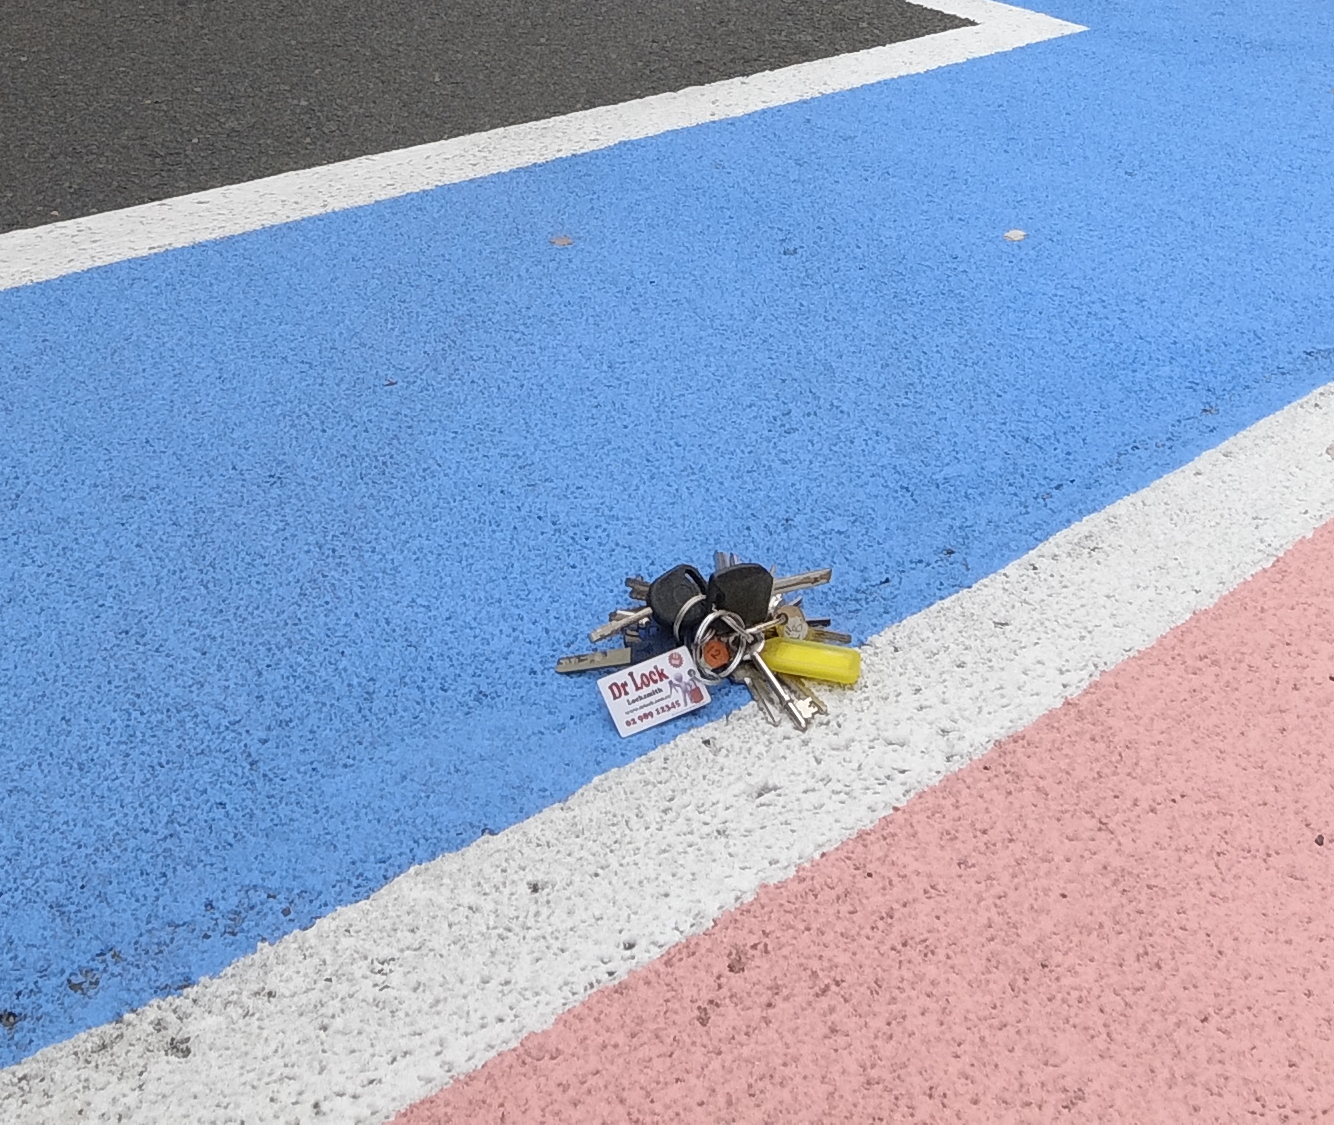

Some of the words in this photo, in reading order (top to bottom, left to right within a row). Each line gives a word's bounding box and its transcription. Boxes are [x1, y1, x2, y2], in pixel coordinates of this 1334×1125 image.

[608, 680, 630, 701] Dr
[627, 665, 669, 692] Lock
[626, 687, 664, 706] Locksmith
[625, 717, 638, 727] 02
[655, 699, 682, 715] 12345
